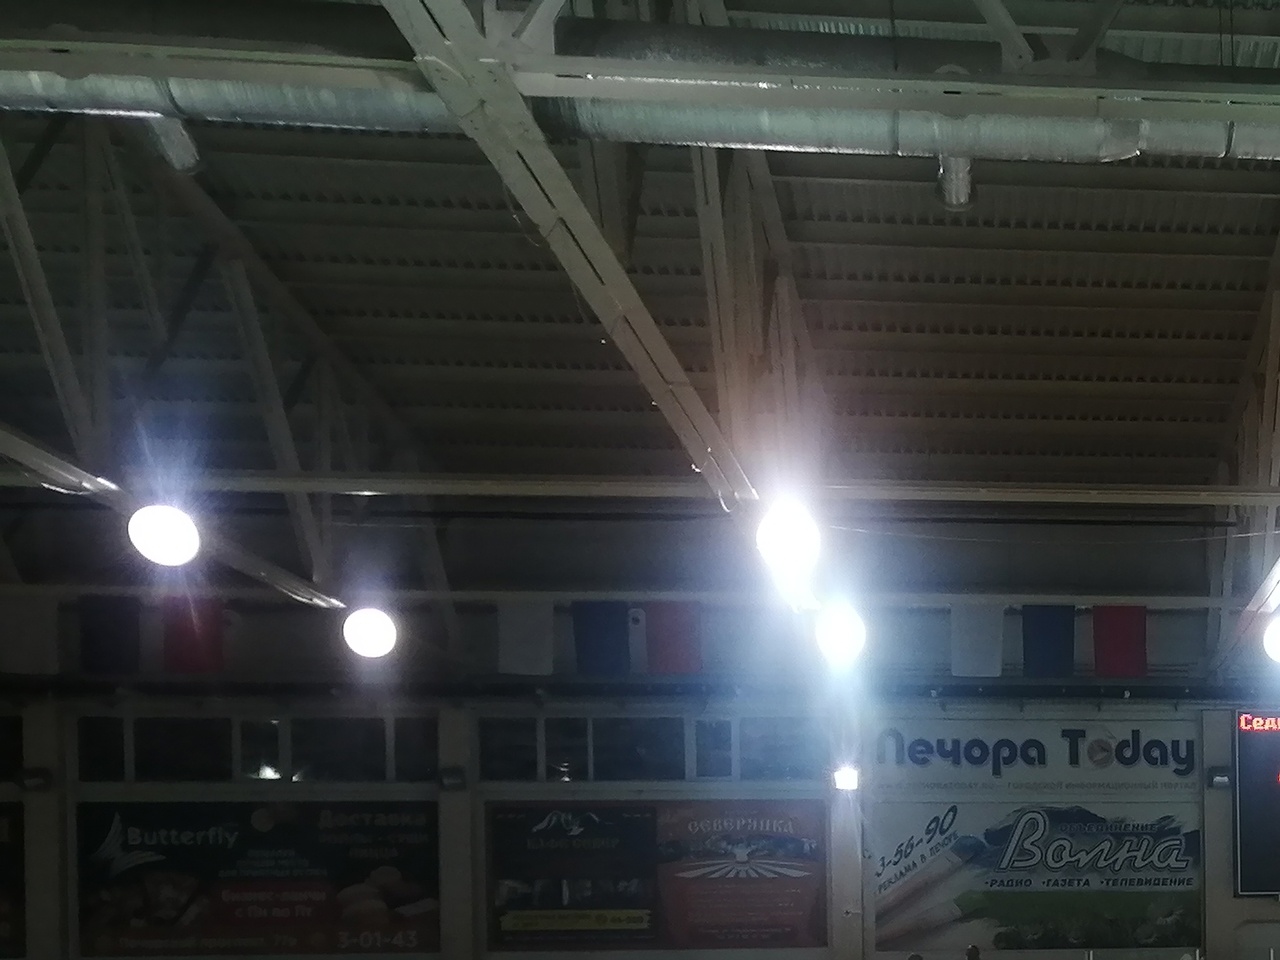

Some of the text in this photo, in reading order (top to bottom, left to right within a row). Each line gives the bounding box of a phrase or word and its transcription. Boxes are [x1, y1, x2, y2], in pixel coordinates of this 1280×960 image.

[877, 728, 1195, 777] Печора Today
[127, 823, 239, 848] Butterfly
[996, 809, 1190, 873] Волна
[989, 876, 1033, 888] РАДИО
[1046, 876, 1091, 888] ГАЗЕТА
